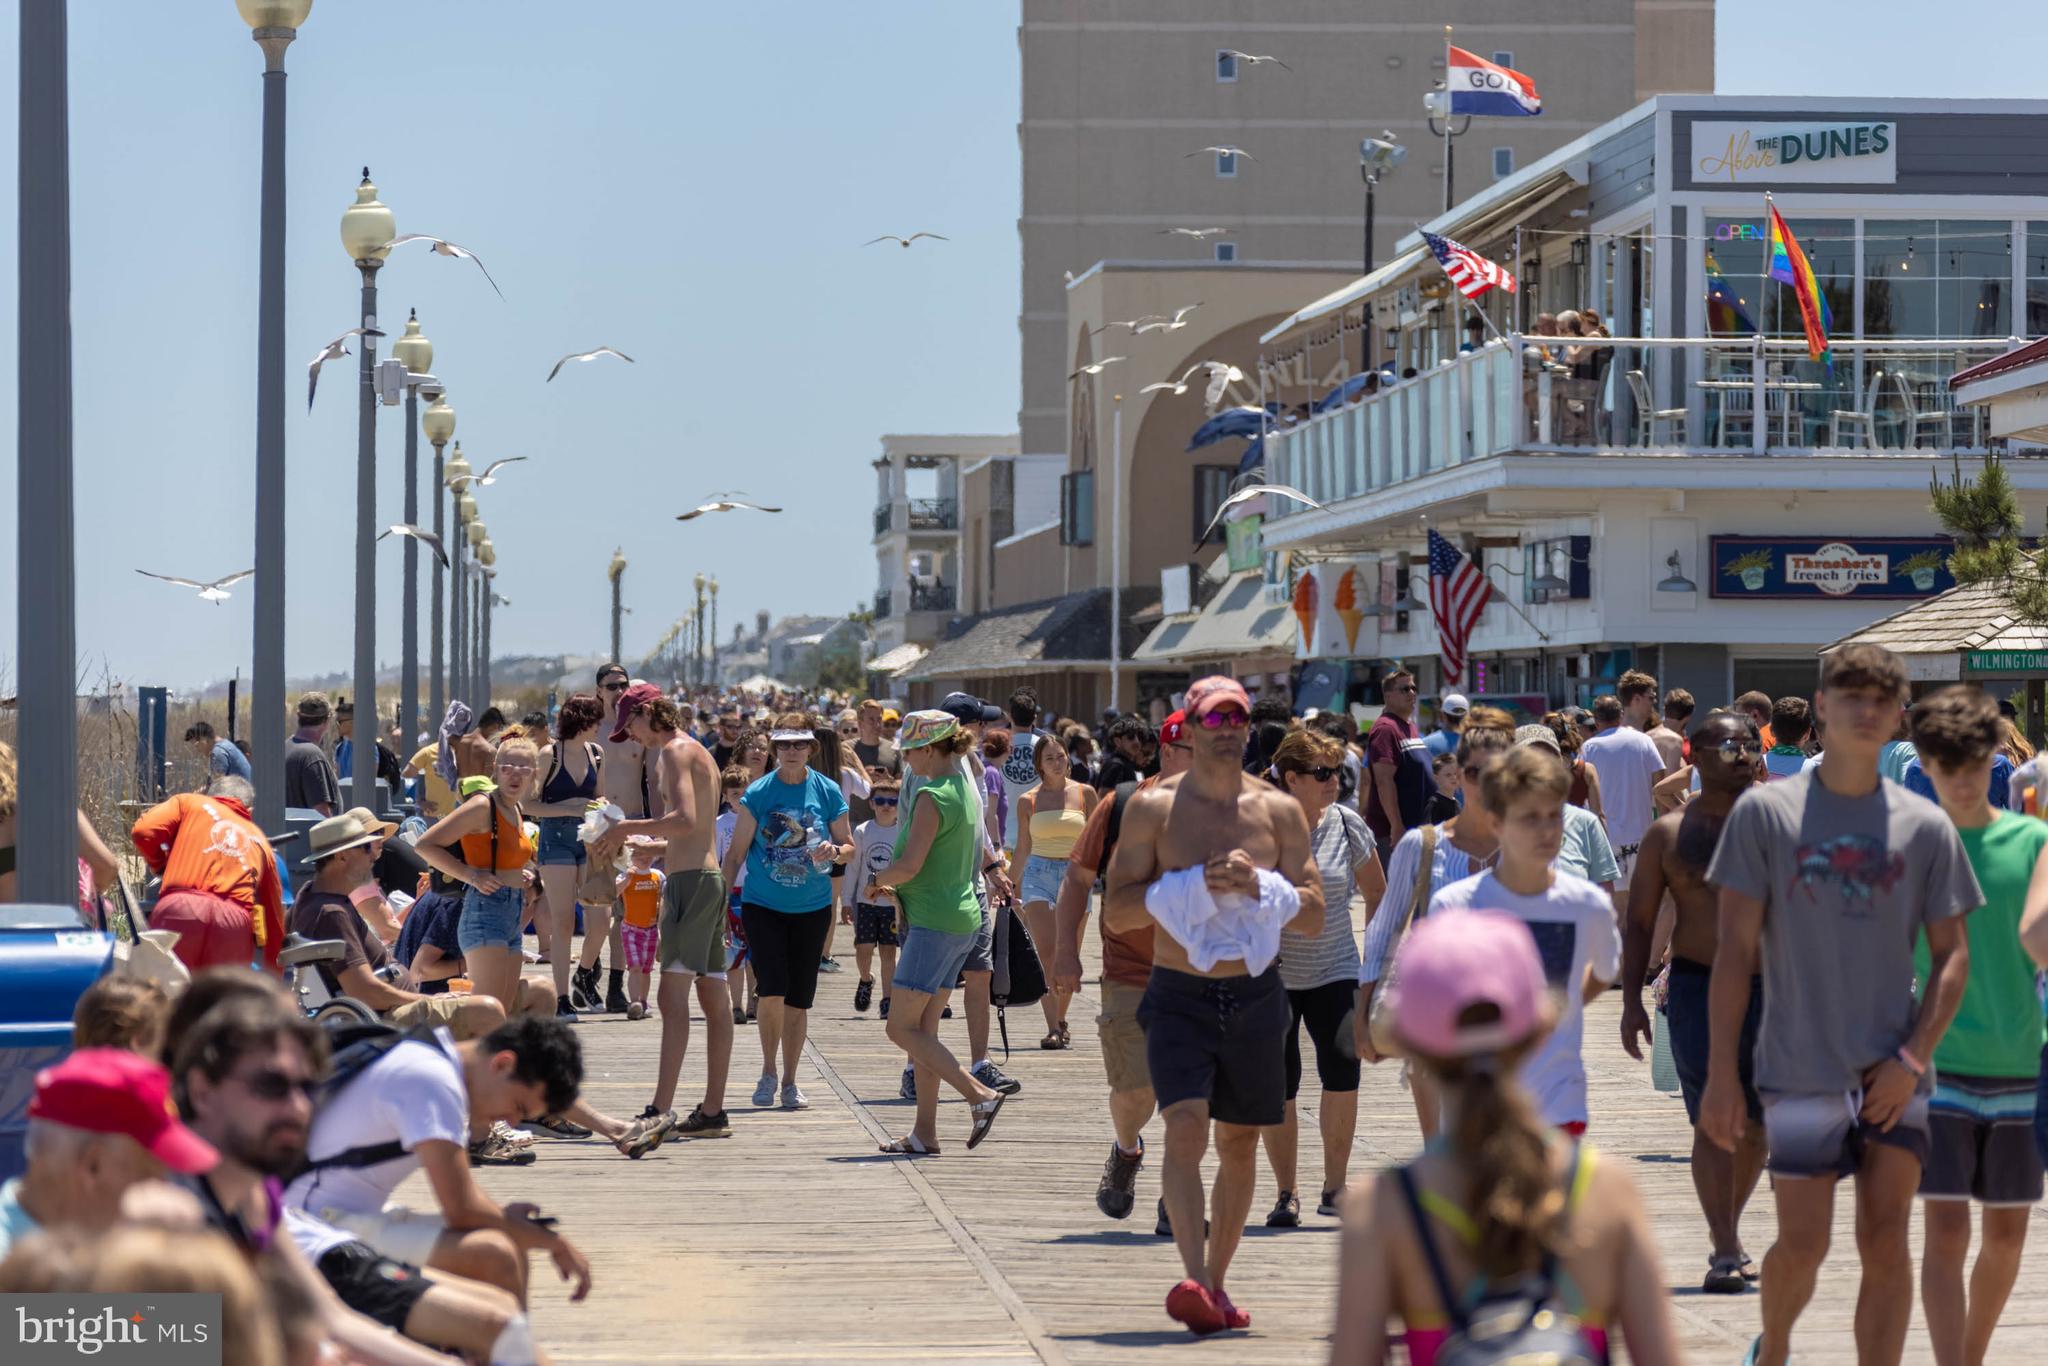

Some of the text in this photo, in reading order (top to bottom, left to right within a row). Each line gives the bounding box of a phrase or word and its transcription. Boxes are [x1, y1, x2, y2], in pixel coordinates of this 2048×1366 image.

[1470, 71, 1519, 94] GOL
[1700, 124, 1889, 182] Above THE DUNES
[1714, 223, 1764, 241] OPEN
[1794, 569, 1880, 580] french fries
[1971, 654, 2043, 669] WILMINGTON
[1005, 764, 1036, 781] BAGE
